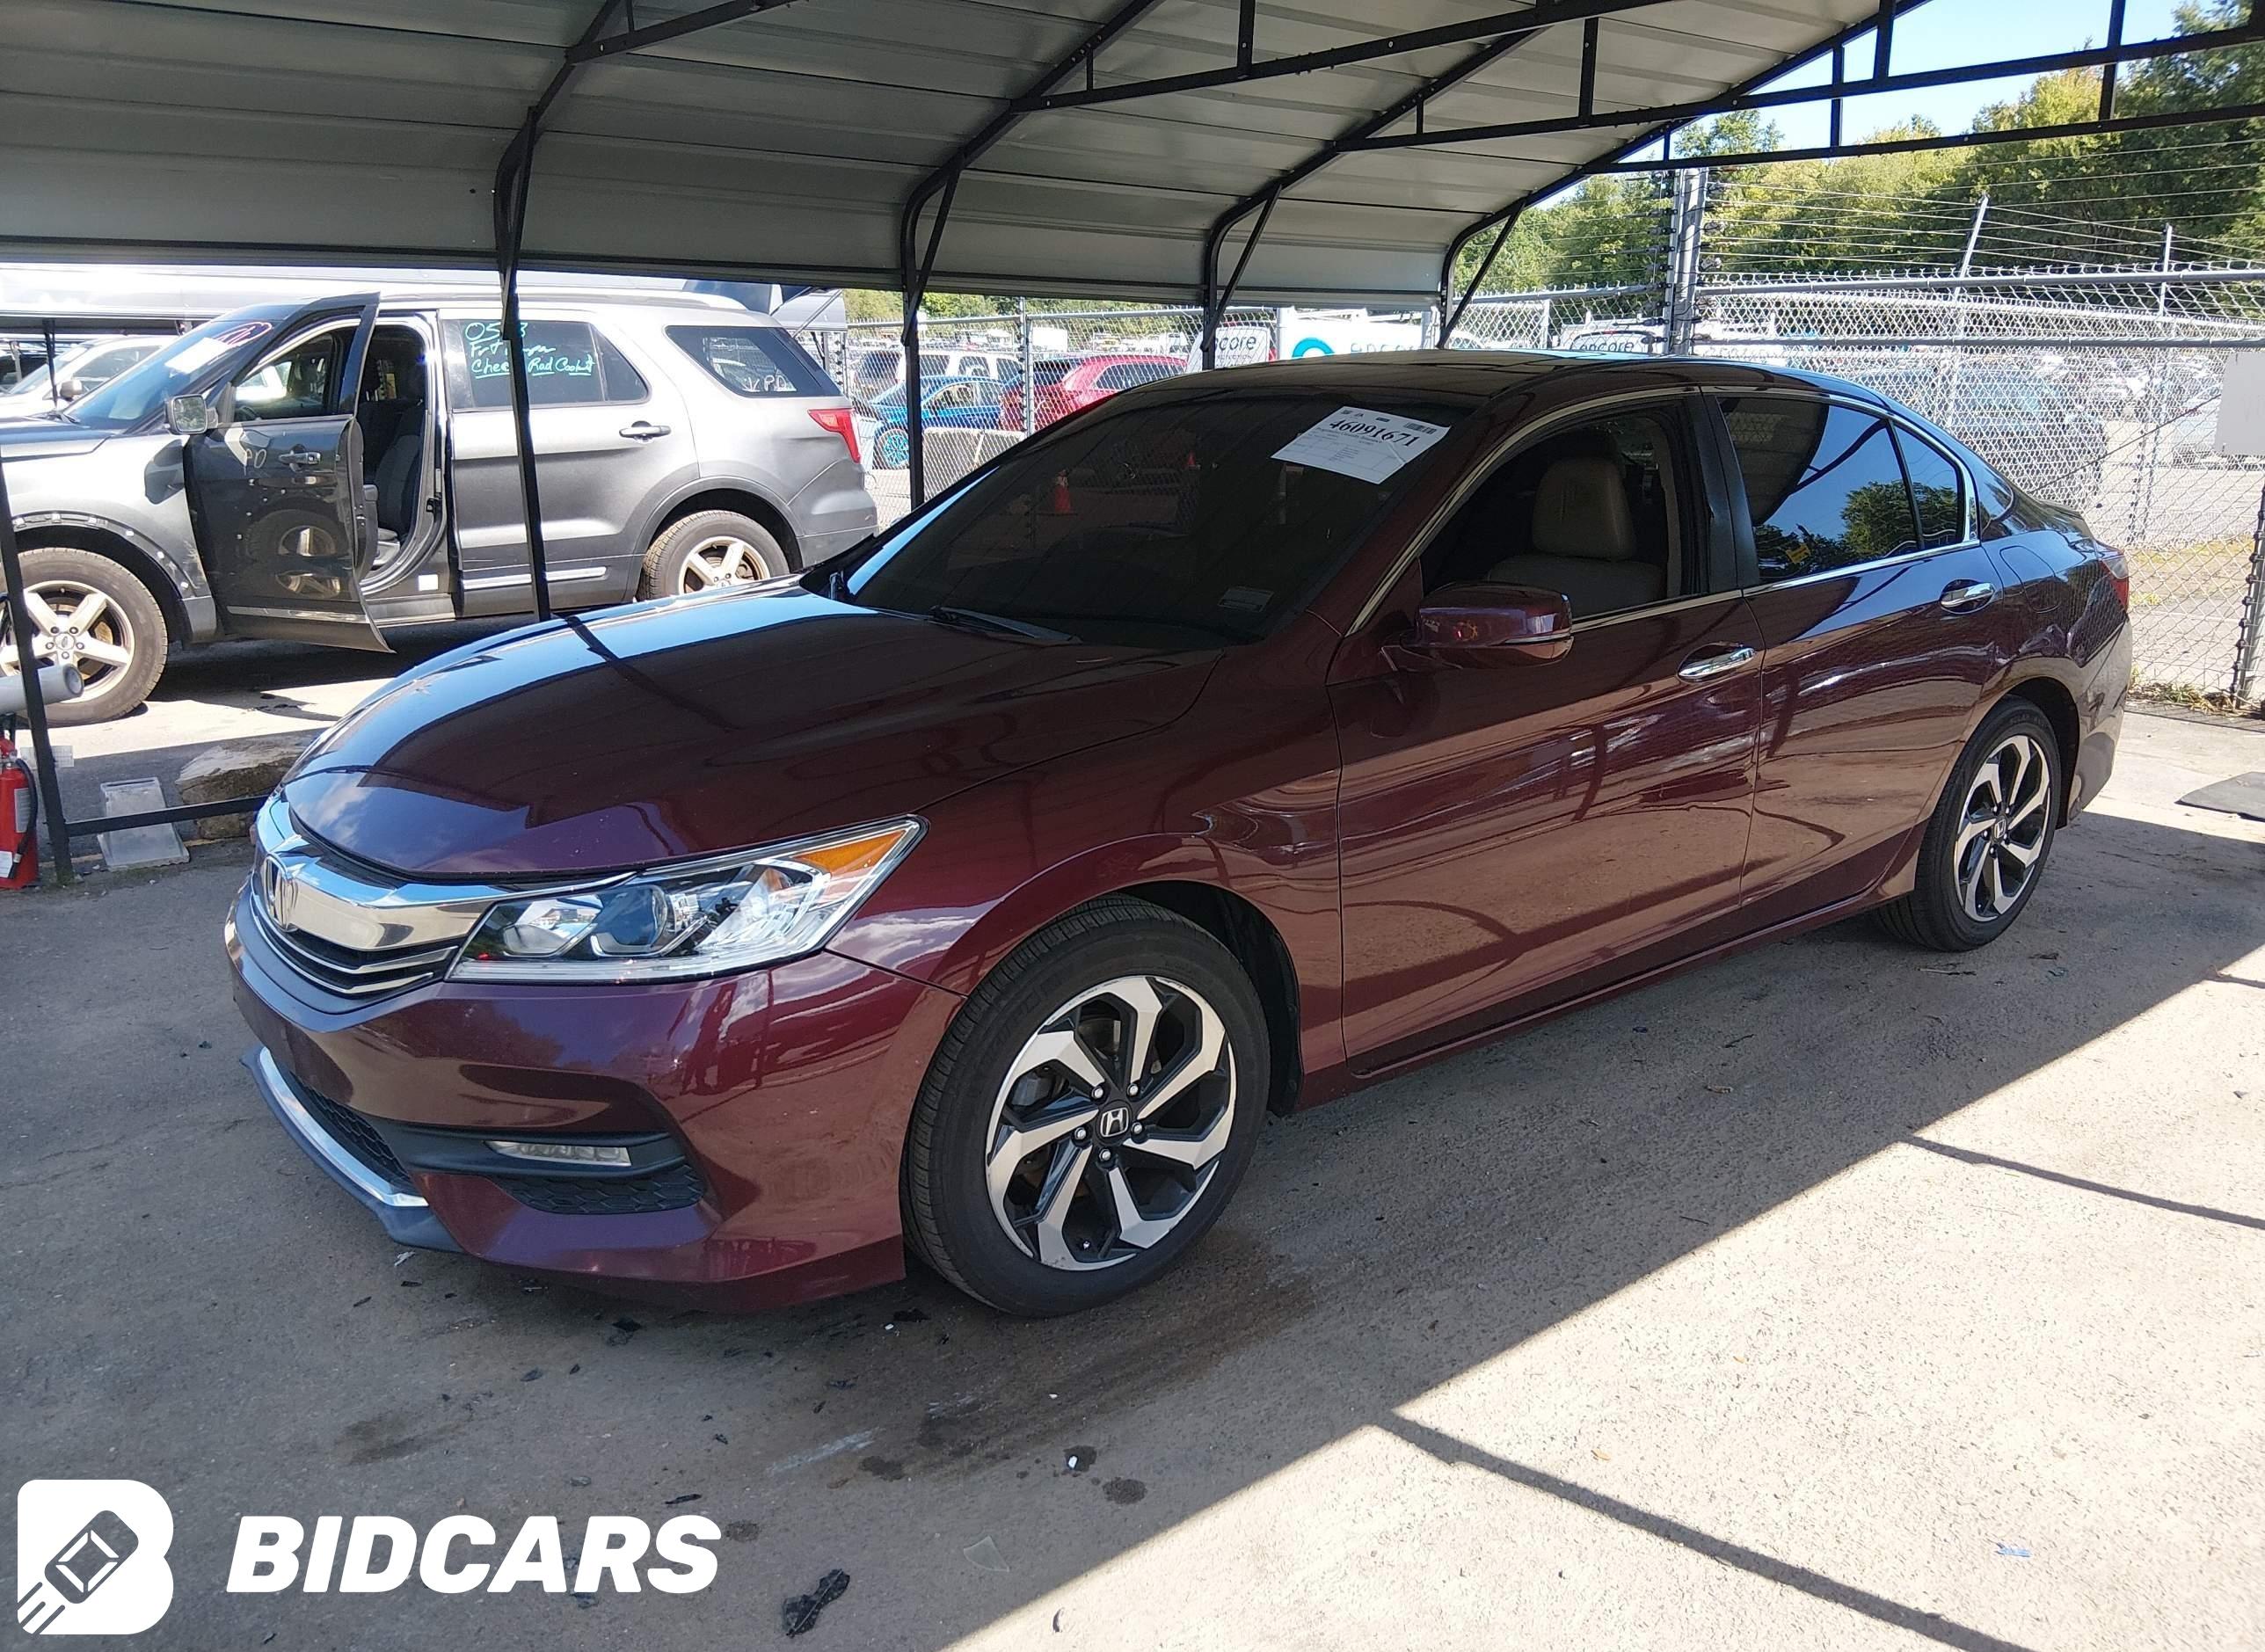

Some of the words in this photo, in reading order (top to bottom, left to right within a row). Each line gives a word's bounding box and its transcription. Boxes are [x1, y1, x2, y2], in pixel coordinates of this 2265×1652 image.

[1215, 336, 1257, 351] core
[471, 357, 511, 373] Chec
[528, 356, 554, 373] Rad
[1329, 419, 1421, 447] 46091671
